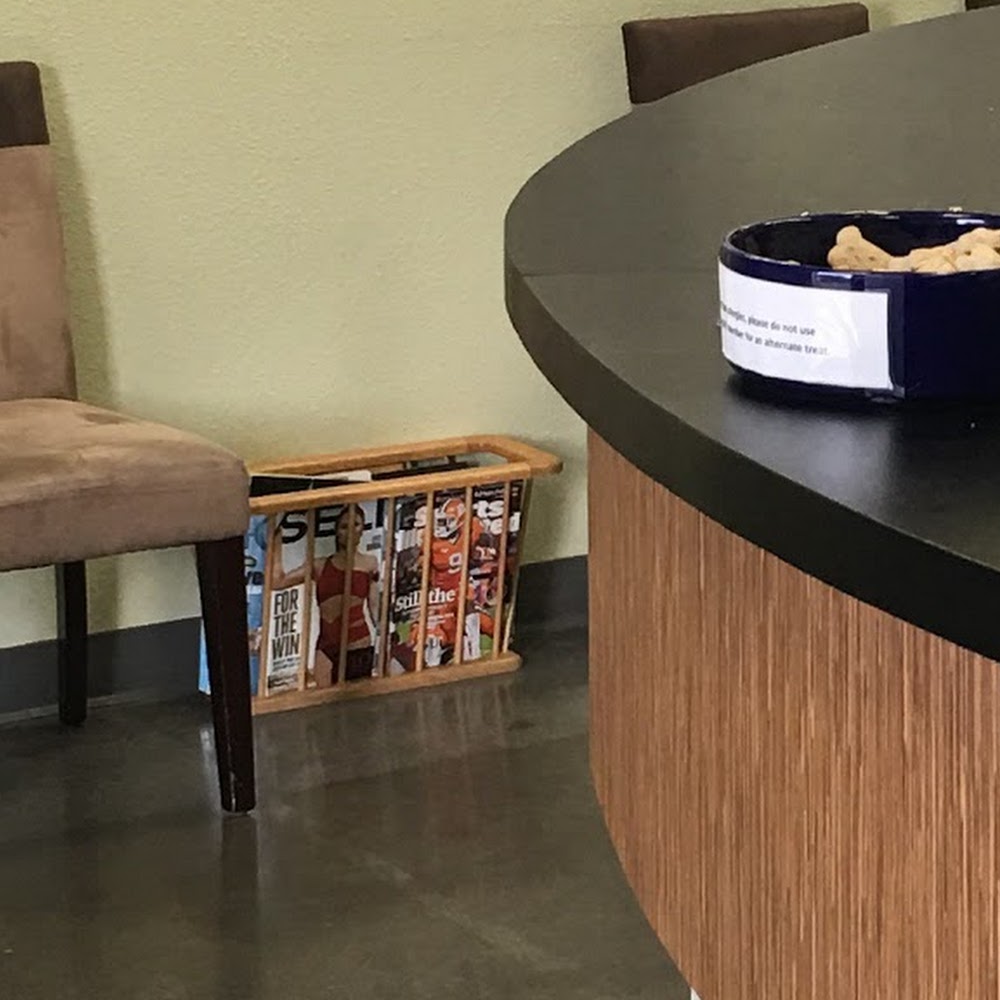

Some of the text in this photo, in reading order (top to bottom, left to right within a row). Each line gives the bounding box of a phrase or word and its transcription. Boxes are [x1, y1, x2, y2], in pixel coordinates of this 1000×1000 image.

[782, 324, 798, 334] not
[799, 327, 816, 336] use
[273, 588, 299, 615] FOR
[394, 586, 456, 612] Stil the
[273, 612, 298, 635] THE
[271, 633, 301, 660] WIN
